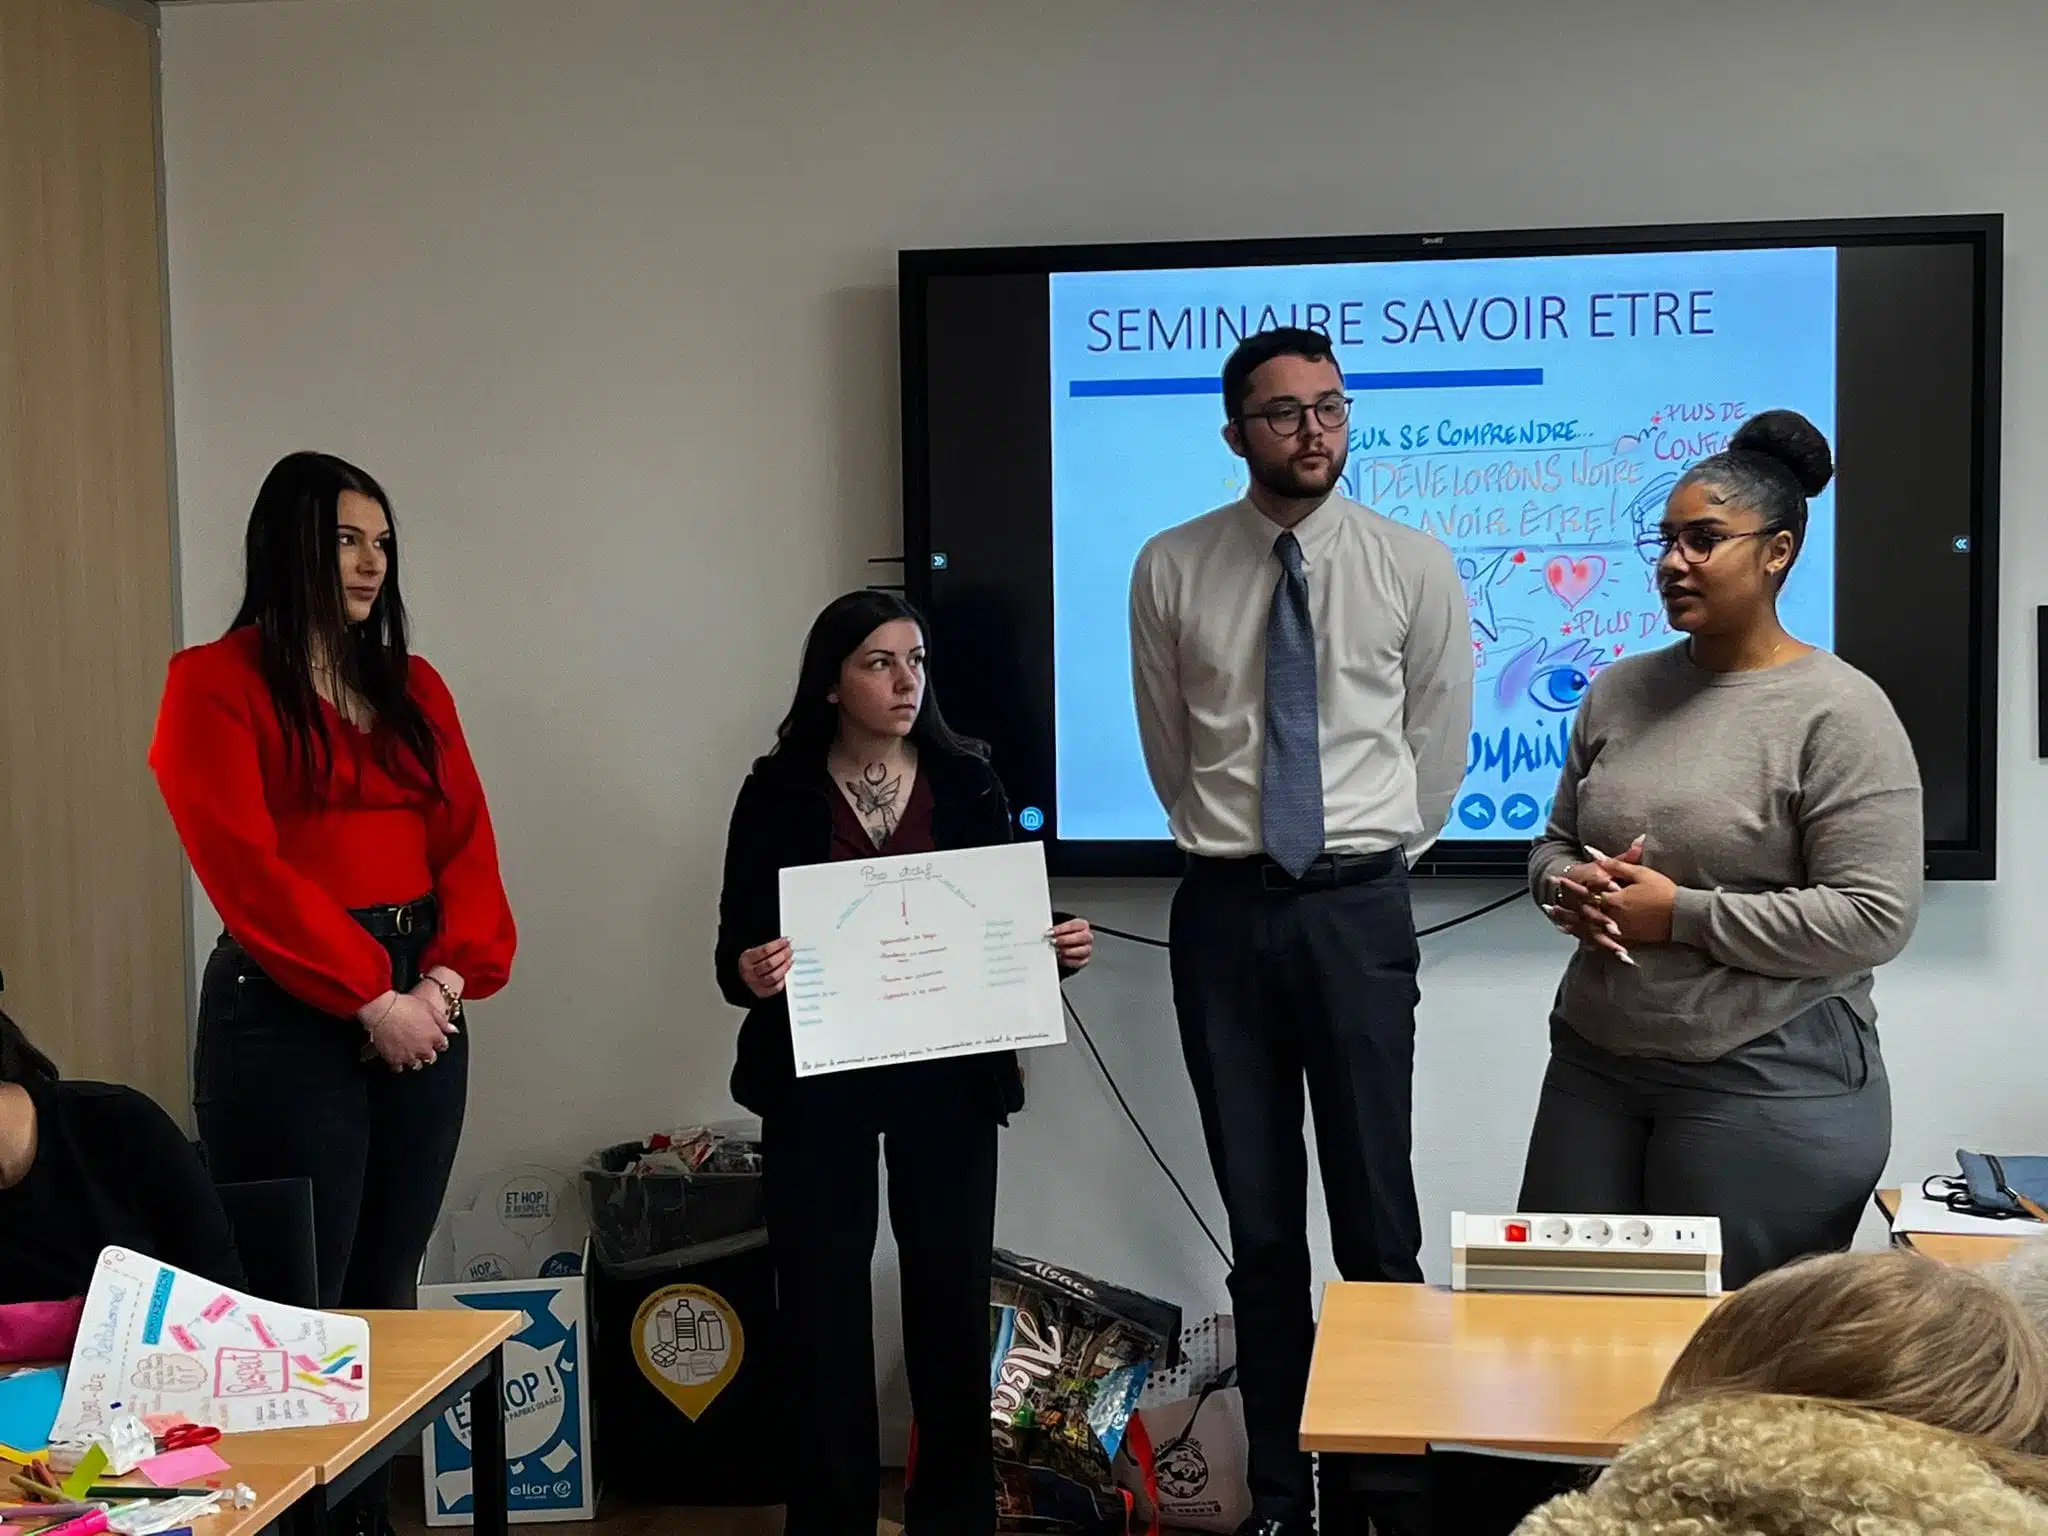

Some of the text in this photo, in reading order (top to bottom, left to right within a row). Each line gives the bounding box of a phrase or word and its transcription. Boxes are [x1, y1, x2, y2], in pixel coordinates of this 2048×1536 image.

[1086, 289, 1716, 352] SEMINAIRE SAVOIR ETRE
[1663, 401, 1749, 423] PLUS DE
[1399, 423, 1431, 451] SE
[1571, 447, 1648, 488] NOTRE
[1572, 608, 1632, 637] PLUS
[505, 1191, 519, 1205] ET
[521, 1191, 544, 1205] HOP
[469, 1260, 491, 1279] HOP
[1015, 1259, 1098, 1299] Alsace
[451, 1395, 472, 1430] E
[504, 1371, 540, 1411] OP
[510, 1482, 551, 1497] elior
